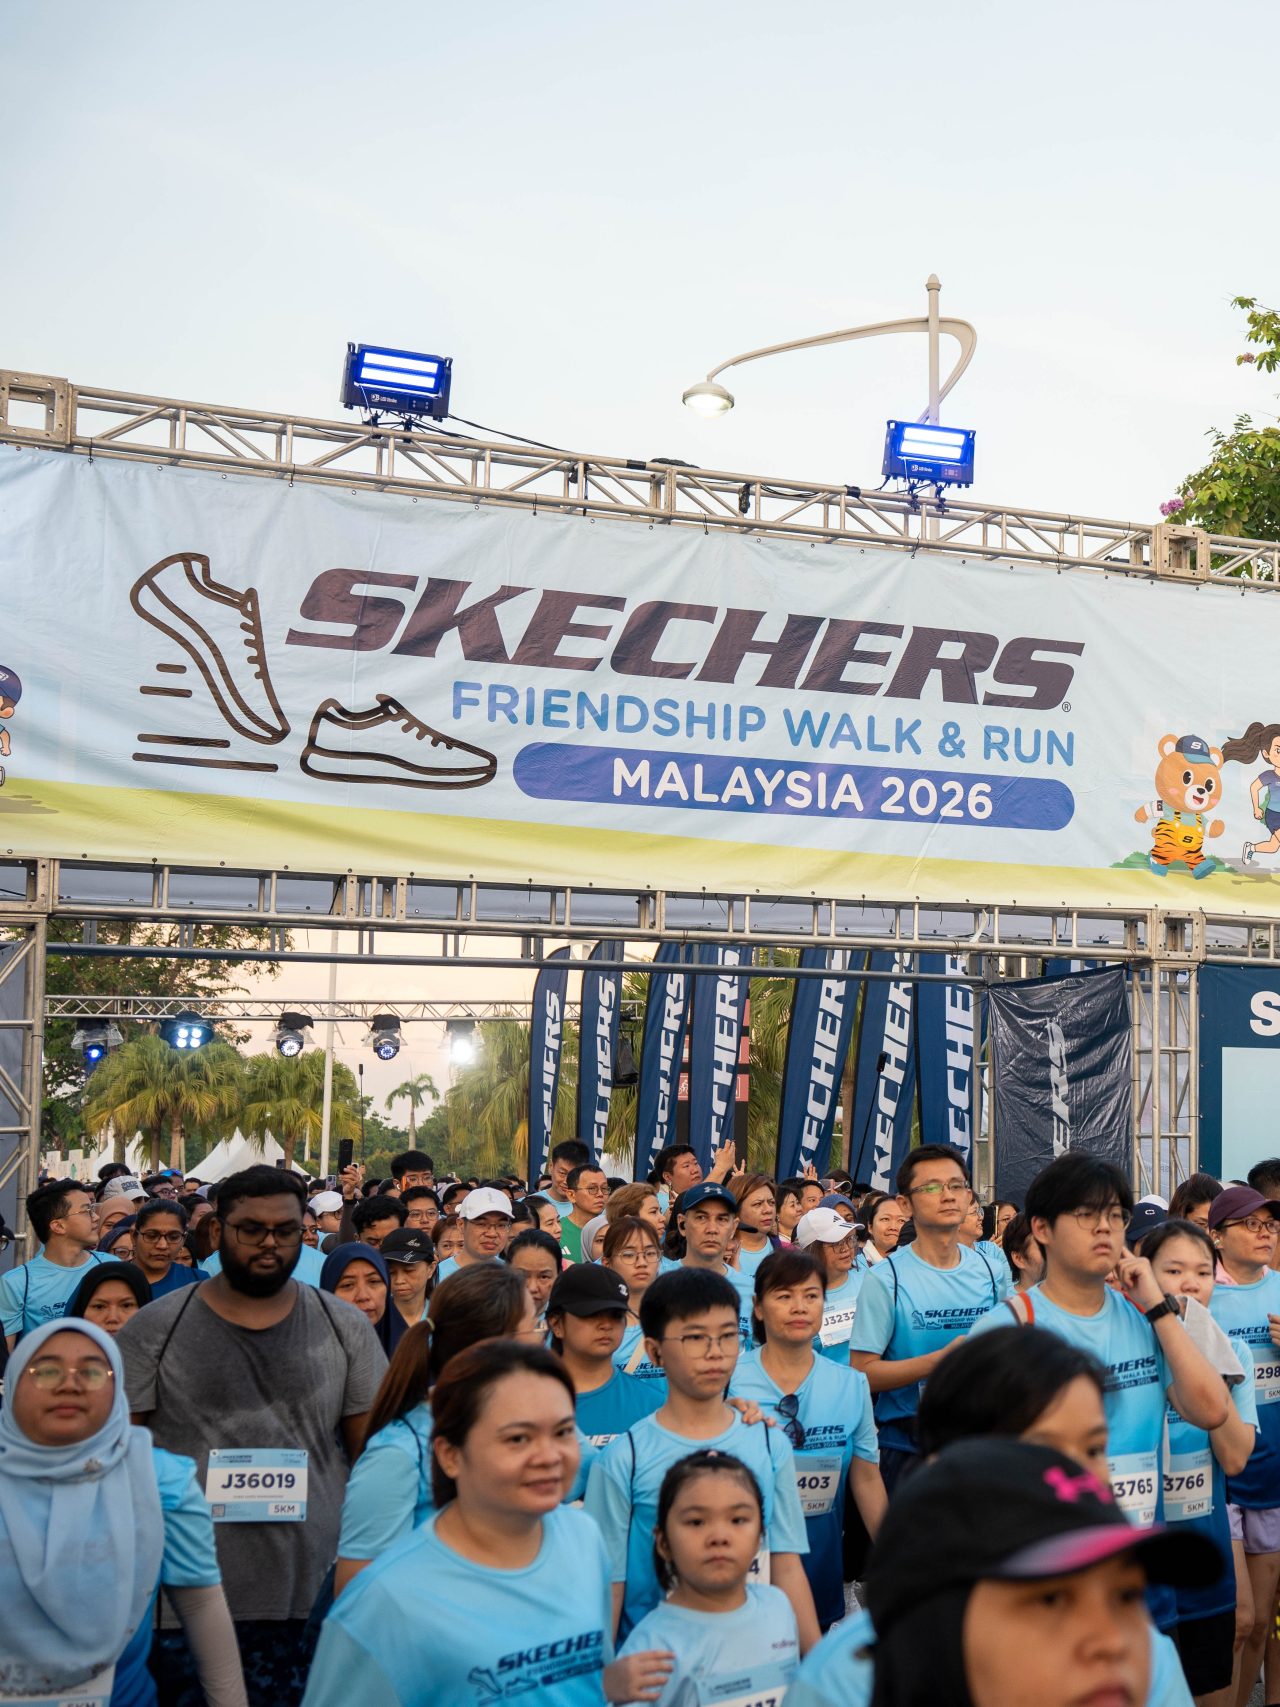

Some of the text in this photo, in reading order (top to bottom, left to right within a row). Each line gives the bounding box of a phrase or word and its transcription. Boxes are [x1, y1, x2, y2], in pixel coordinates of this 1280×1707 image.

[286, 567, 1085, 710] SKECHERS
[452, 681, 1075, 767] FRIENDSHIP WALK & RUN
[613, 758, 993, 820] MALAYSIA 2026
[823, 1311, 856, 1327] J3232
[1228, 1326, 1269, 1337] SKECH
[1111, 1355, 1157, 1374] HERS
[805, 1424, 845, 1437] HERS
[221, 1473, 296, 1489] J36019
[797, 1476, 830, 1489] 403
[1114, 1478, 1153, 1498] 3765
[1163, 1473, 1205, 1491] 3766
[274, 1504, 295, 1513] 5KM
[807, 1502, 825, 1511] 5KM
[1187, 1502, 1205, 1513] 5KM
